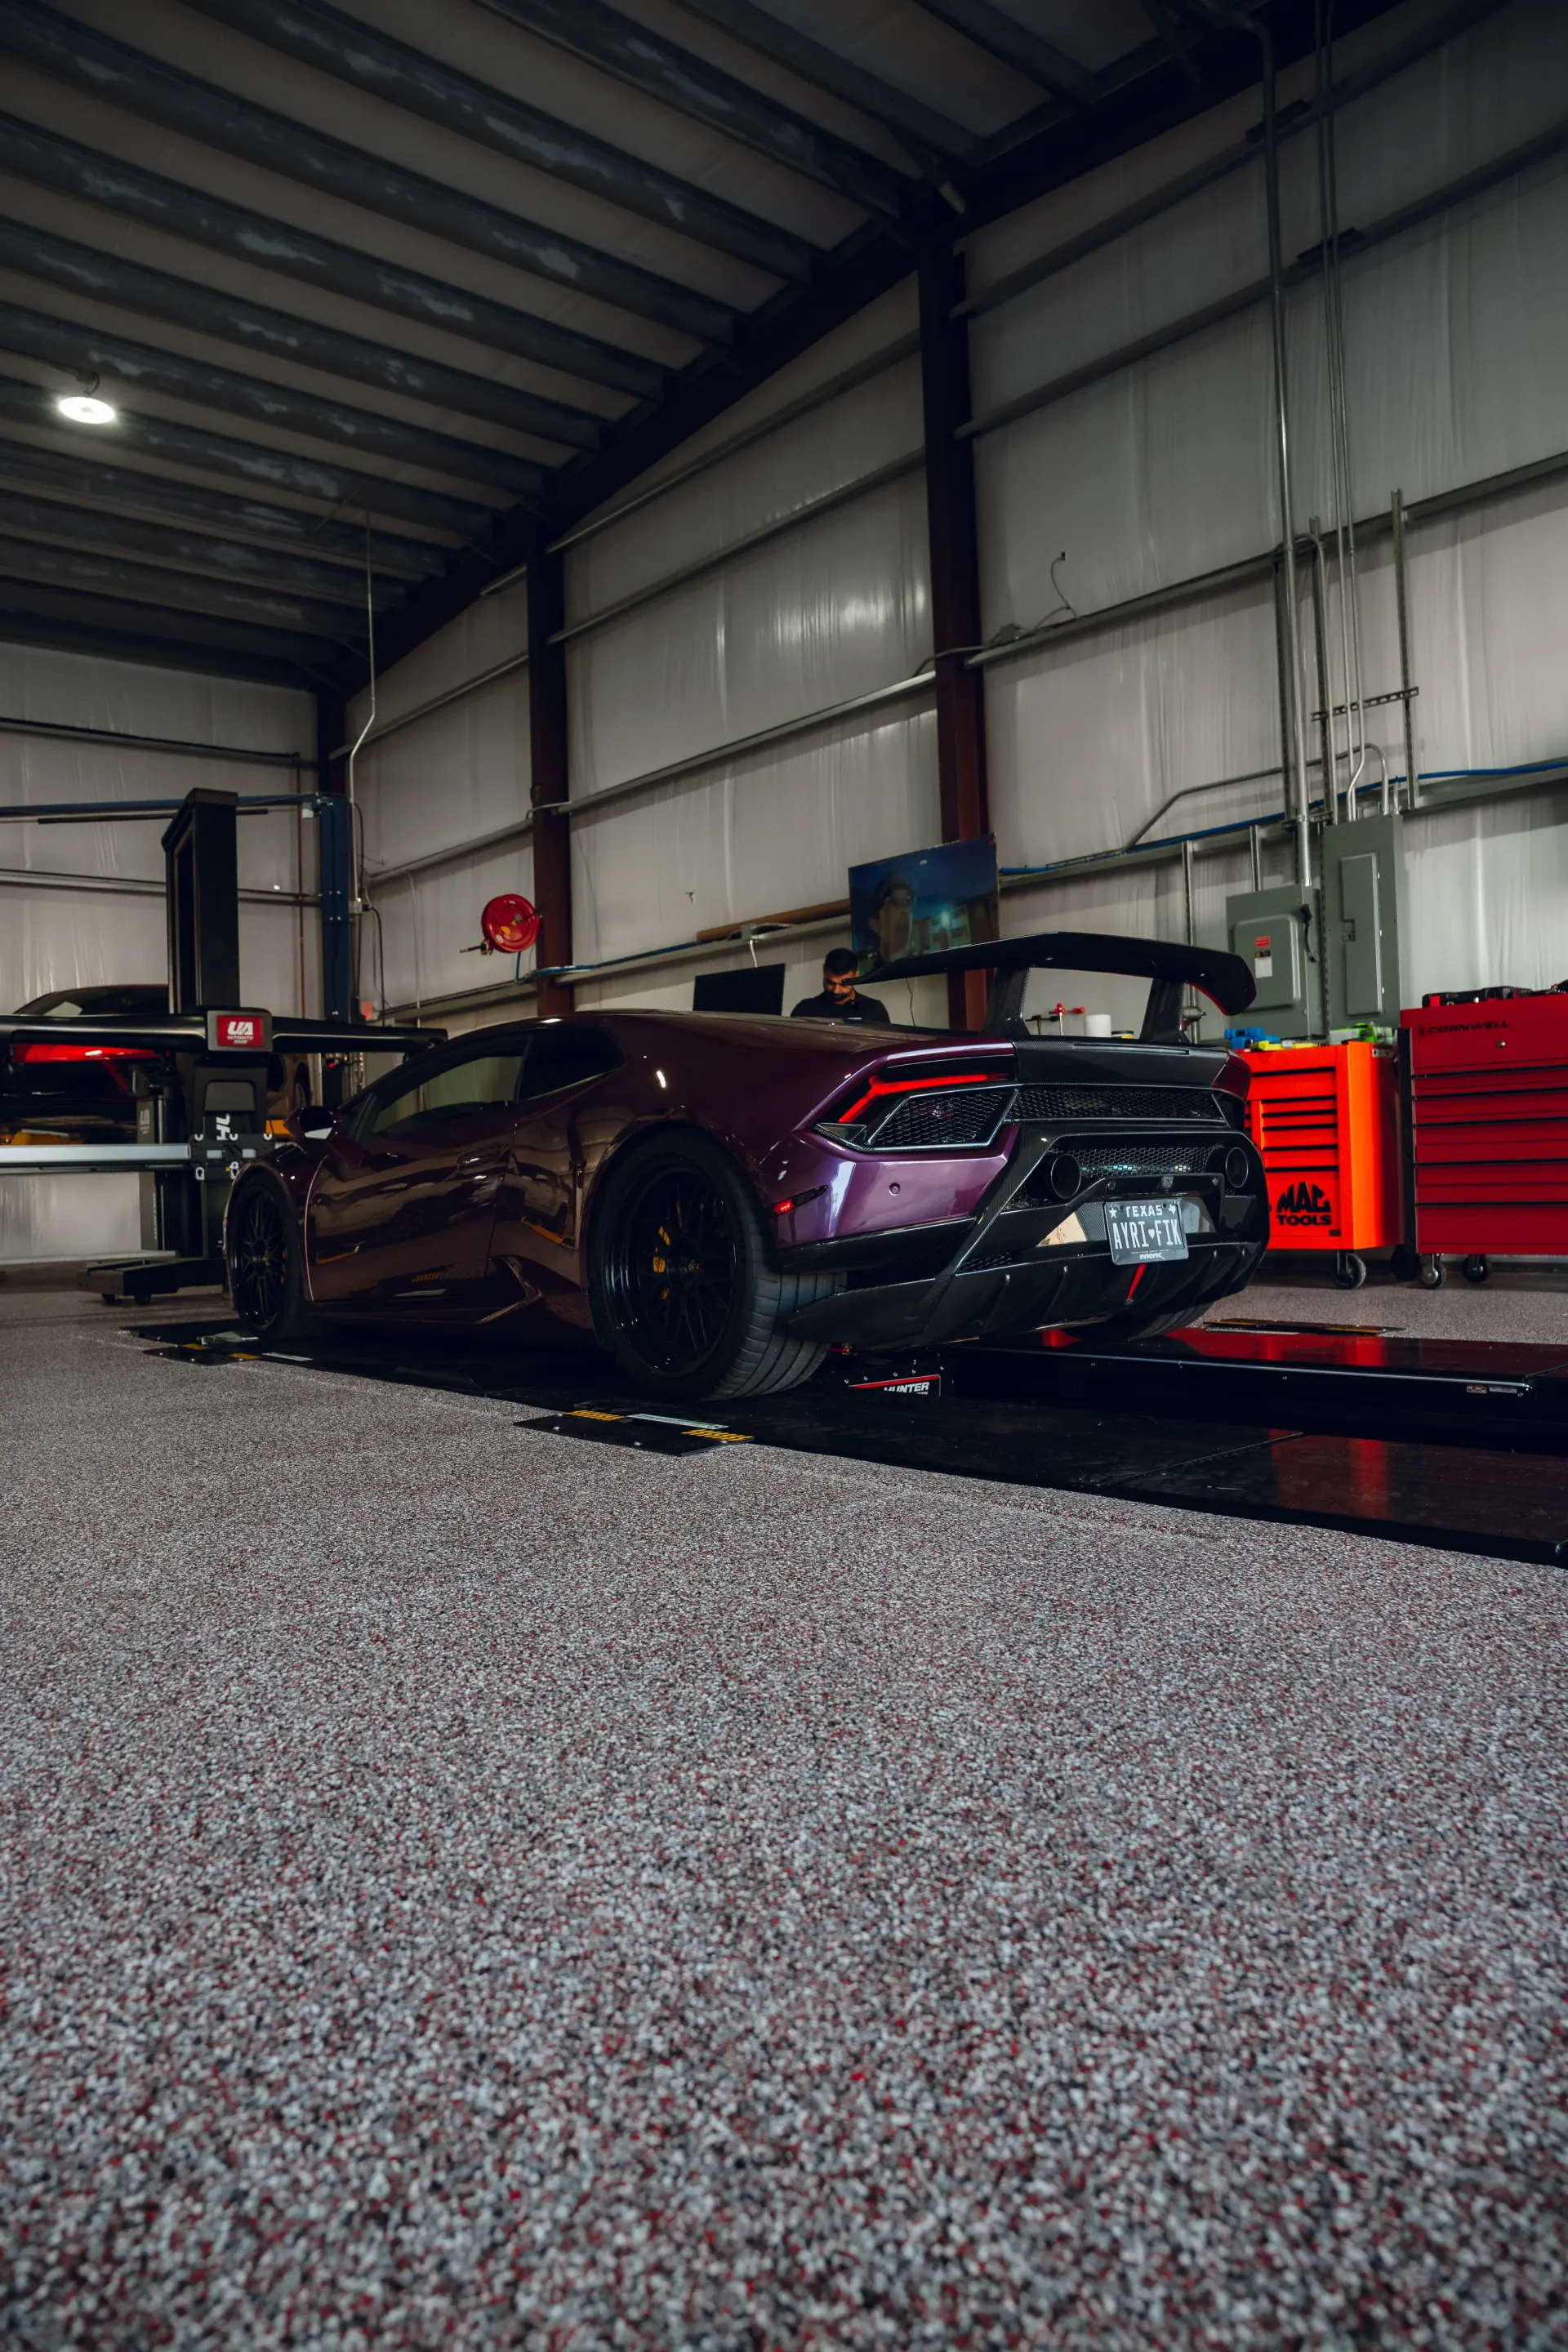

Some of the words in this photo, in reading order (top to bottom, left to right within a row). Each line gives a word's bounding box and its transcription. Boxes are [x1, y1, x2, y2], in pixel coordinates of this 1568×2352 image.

[1428, 1020, 1509, 1035] CORNWELL
[1276, 1181, 1332, 1213] MAC
[1125, 1205, 1163, 1218] TEXAS
[1276, 1214, 1332, 1226] TOOLS
